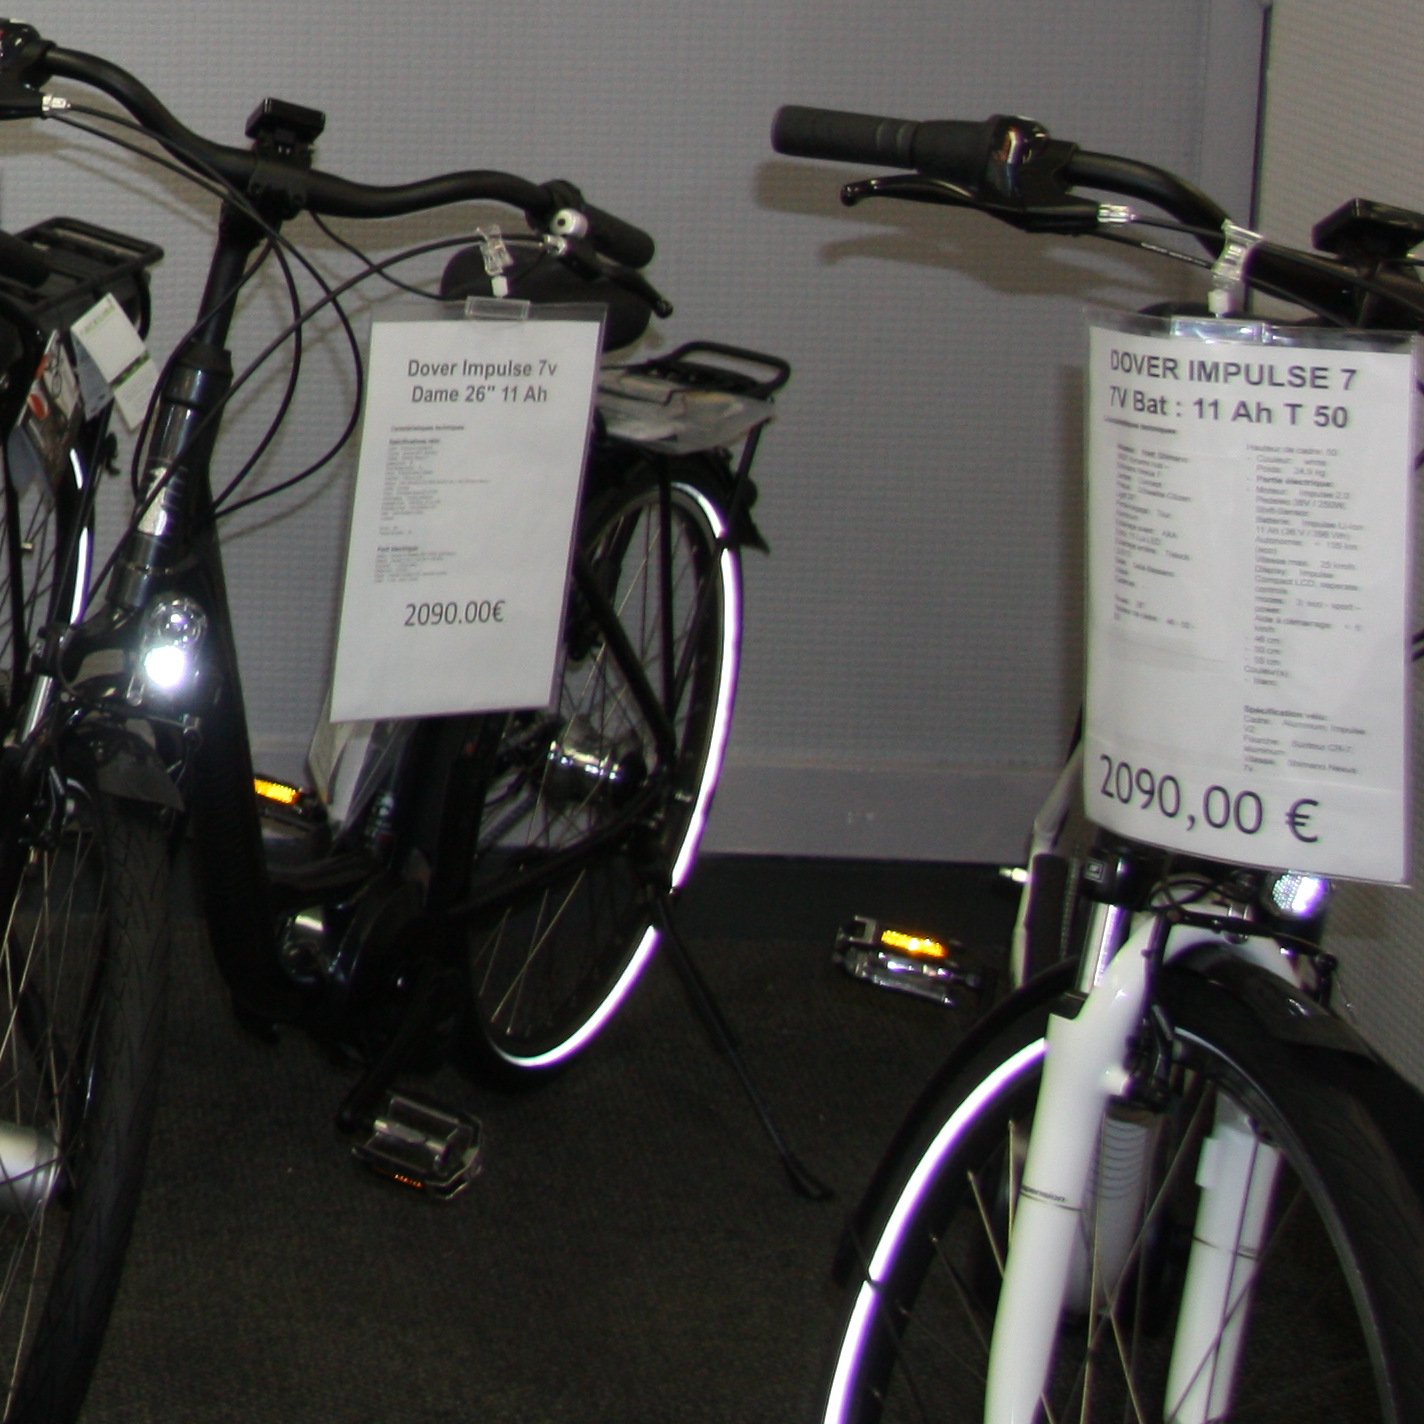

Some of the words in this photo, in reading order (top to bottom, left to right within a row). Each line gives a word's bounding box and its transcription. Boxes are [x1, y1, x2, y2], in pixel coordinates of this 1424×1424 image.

[407, 359, 458, 378] Dover
[462, 359, 532, 380] Impulse
[537, 359, 558, 377] 7v
[1110, 349, 1180, 382] DOVER
[1188, 359, 1329, 391] IMPULSE
[1341, 368, 1358, 391] 7
[411, 385, 459, 404] Dame
[501, 385, 518, 402] 11
[523, 384, 548, 403] Ah
[1109, 385, 1128, 411] 7V
[1132, 389, 1168, 417] Bat
[1192, 398, 1221, 422] 11
[1231, 400, 1273, 426] Ah
[1283, 403, 1303, 426] T
[1313, 404, 1349, 429] 50
[1099, 753, 1263, 836] 2090,00
[1285, 798, 1321, 844] €
